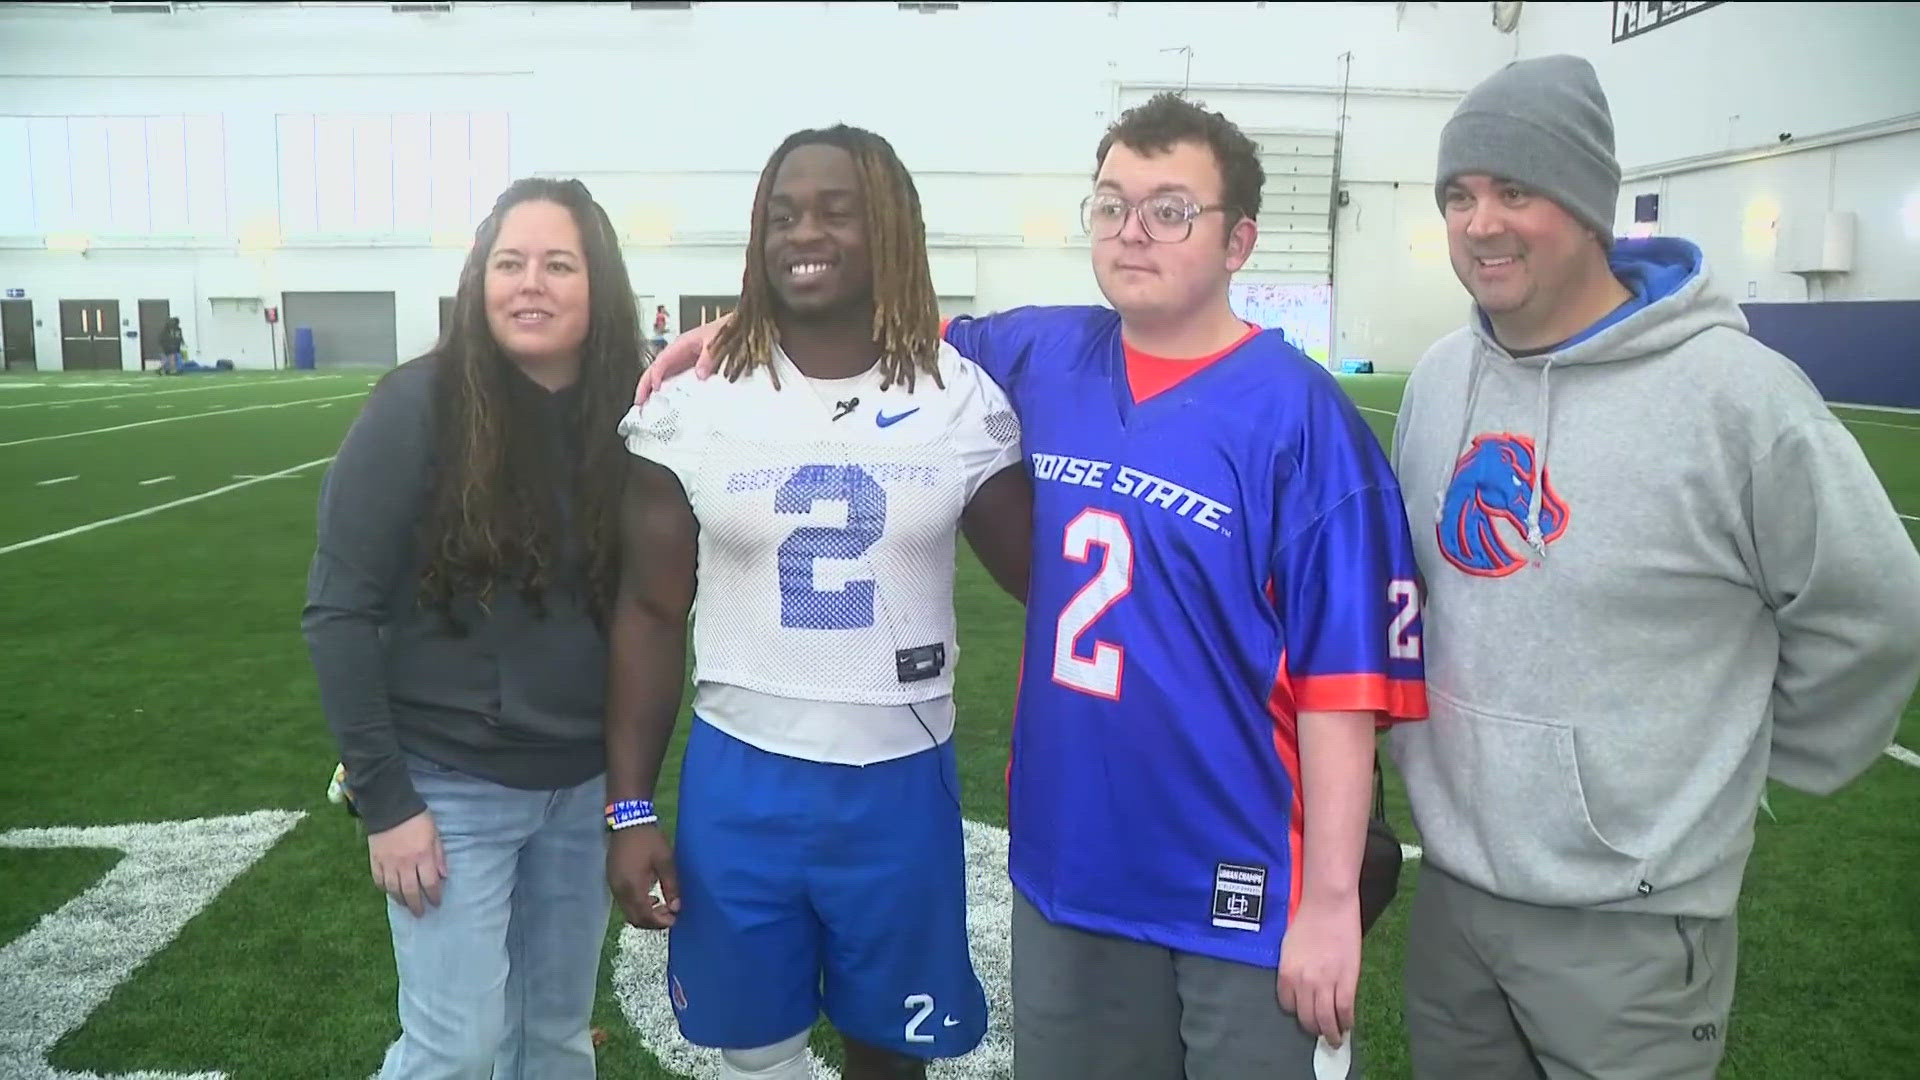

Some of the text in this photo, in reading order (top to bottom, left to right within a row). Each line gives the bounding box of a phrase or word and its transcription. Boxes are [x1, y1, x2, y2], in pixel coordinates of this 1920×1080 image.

[1111, 465, 1233, 531] STATE
[774, 465, 887, 630] 2
[1052, 506, 1135, 701] 2
[1387, 579, 1420, 660] 2
[904, 993, 935, 1044] 2
[1692, 1022, 1717, 1041] OR
